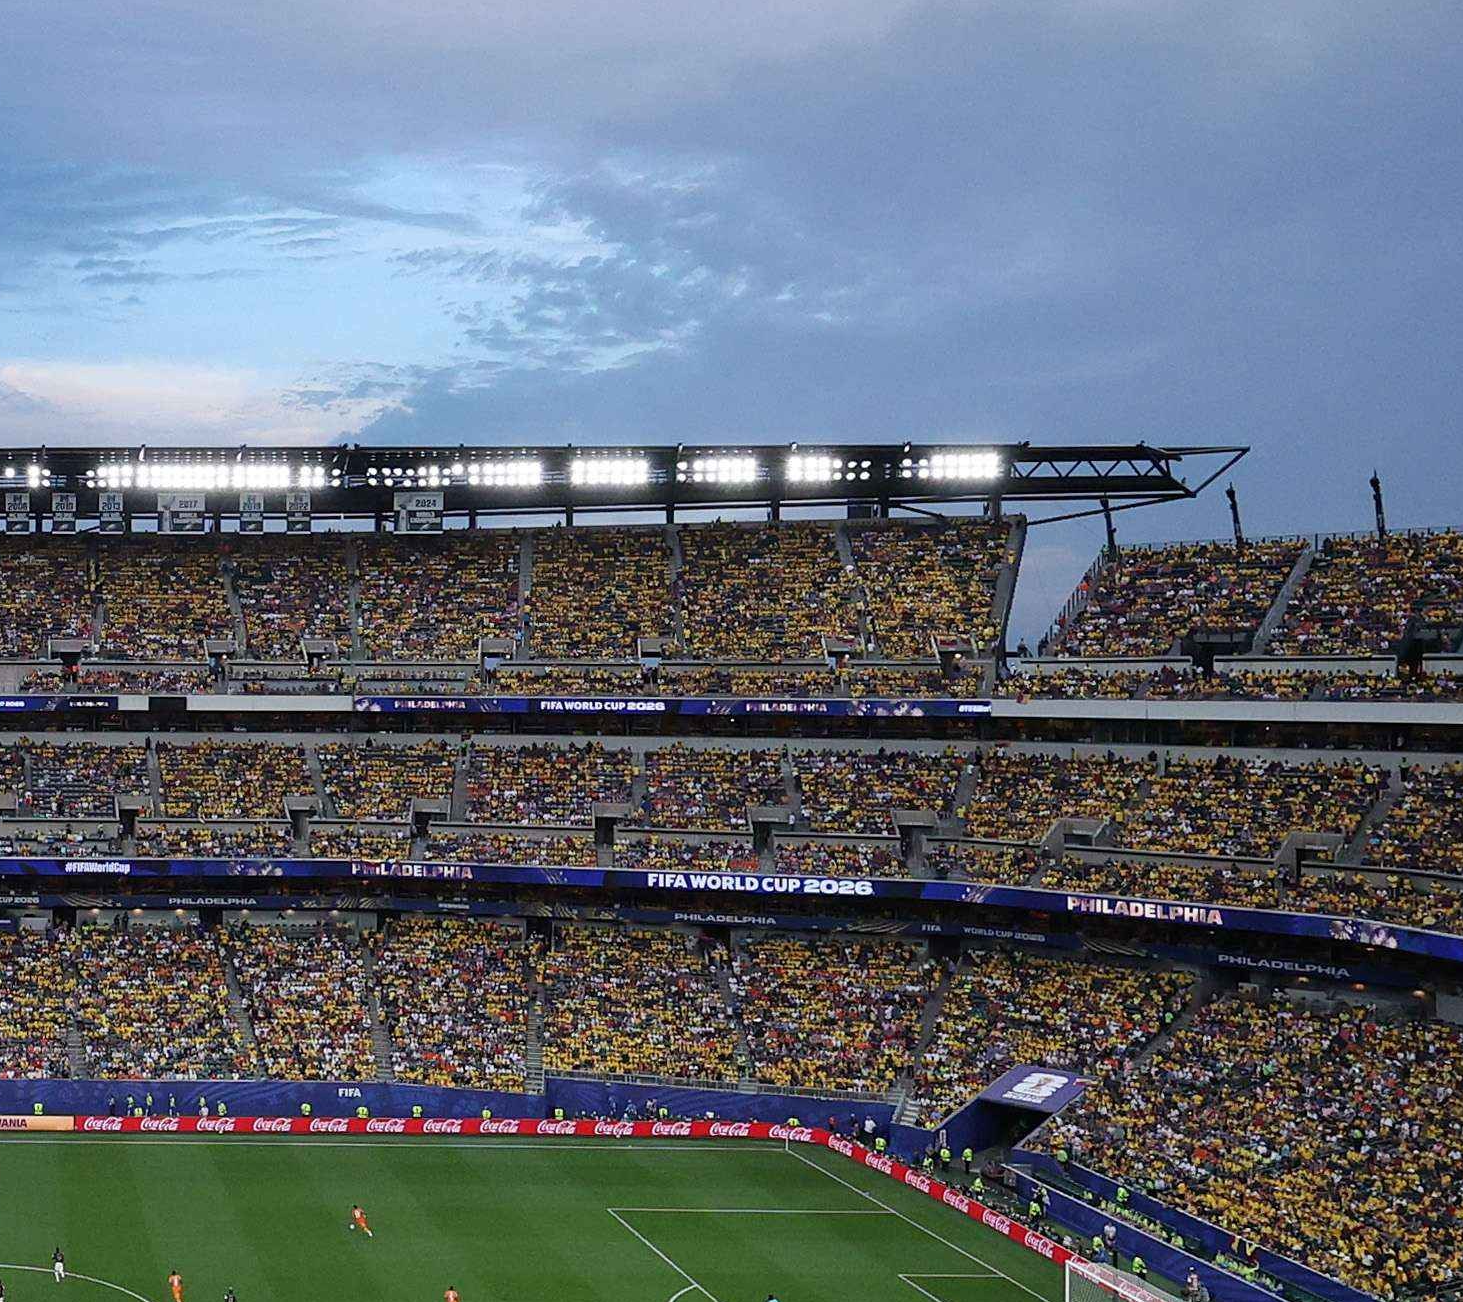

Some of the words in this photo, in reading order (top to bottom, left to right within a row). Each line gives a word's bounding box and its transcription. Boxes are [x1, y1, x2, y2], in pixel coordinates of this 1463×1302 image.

[541, 701, 563, 710] FIFA
[565, 701, 603, 710] WORLD
[604, 702, 625, 711] CUP
[65, 862, 131, 876] #FIFAWorldCup
[648, 873, 687, 889] FIFA
[690, 874, 759, 891] WORLD
[762, 877, 801, 894] CUP
[803, 879, 873, 895] 2026
[1067, 897, 1223, 925] PHILADELPHIA
[674, 912, 777, 926] PHILADELPHIA
[1218, 954, 1351, 978] PHILADELPHIA
[338, 1087, 362, 1098] FIFA
